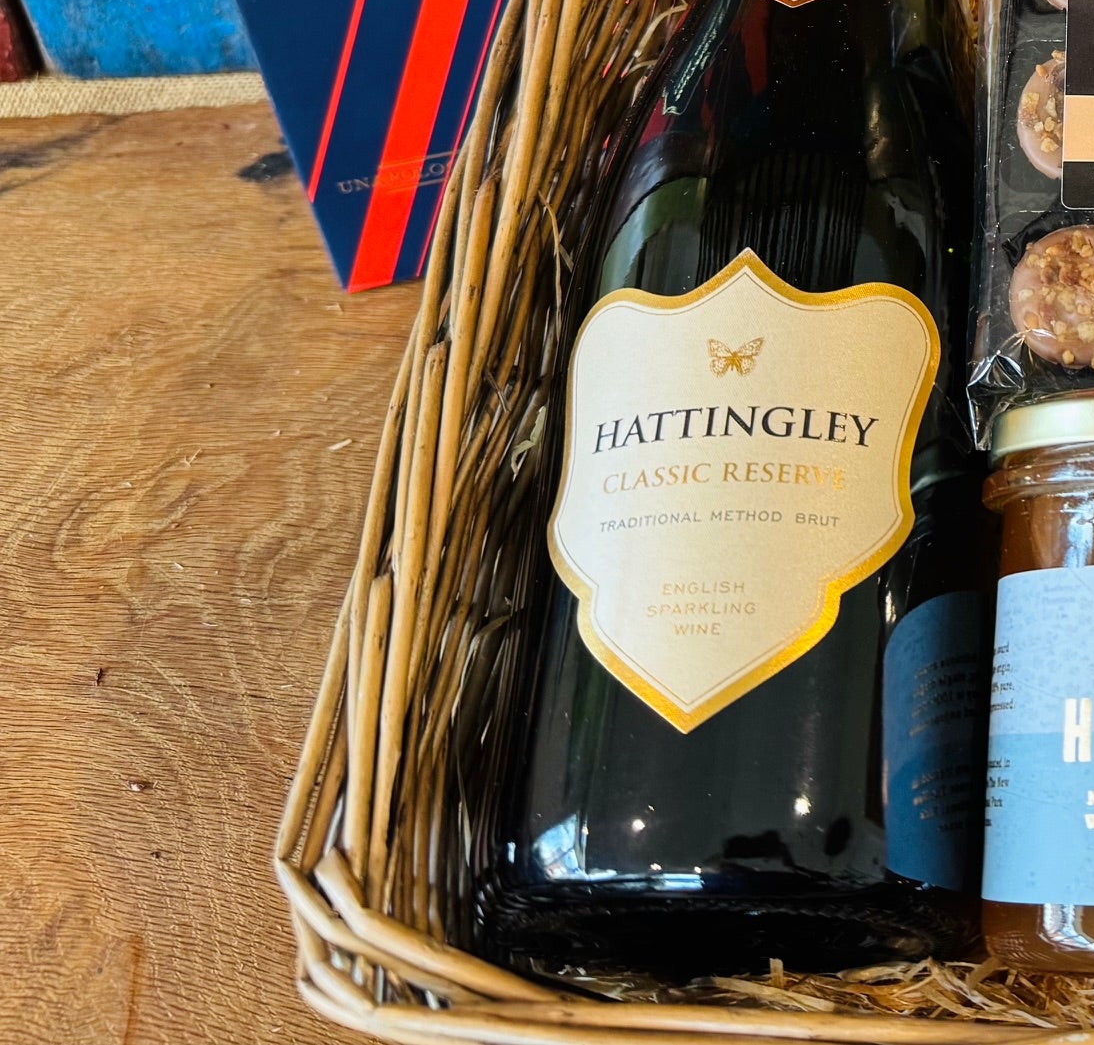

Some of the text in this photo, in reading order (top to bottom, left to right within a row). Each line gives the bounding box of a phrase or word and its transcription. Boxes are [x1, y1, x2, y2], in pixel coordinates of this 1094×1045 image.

[592, 405, 879, 454] HATTINGLEY
[603, 461, 848, 494] CLASSIC RESERVE
[600, 509, 840, 533] TRADITIONAL METHOD BRUT
[662, 581, 745, 596] ENGLISH
[646, 602, 757, 617] SPARKLING
[674, 622, 722, 636] WINE
